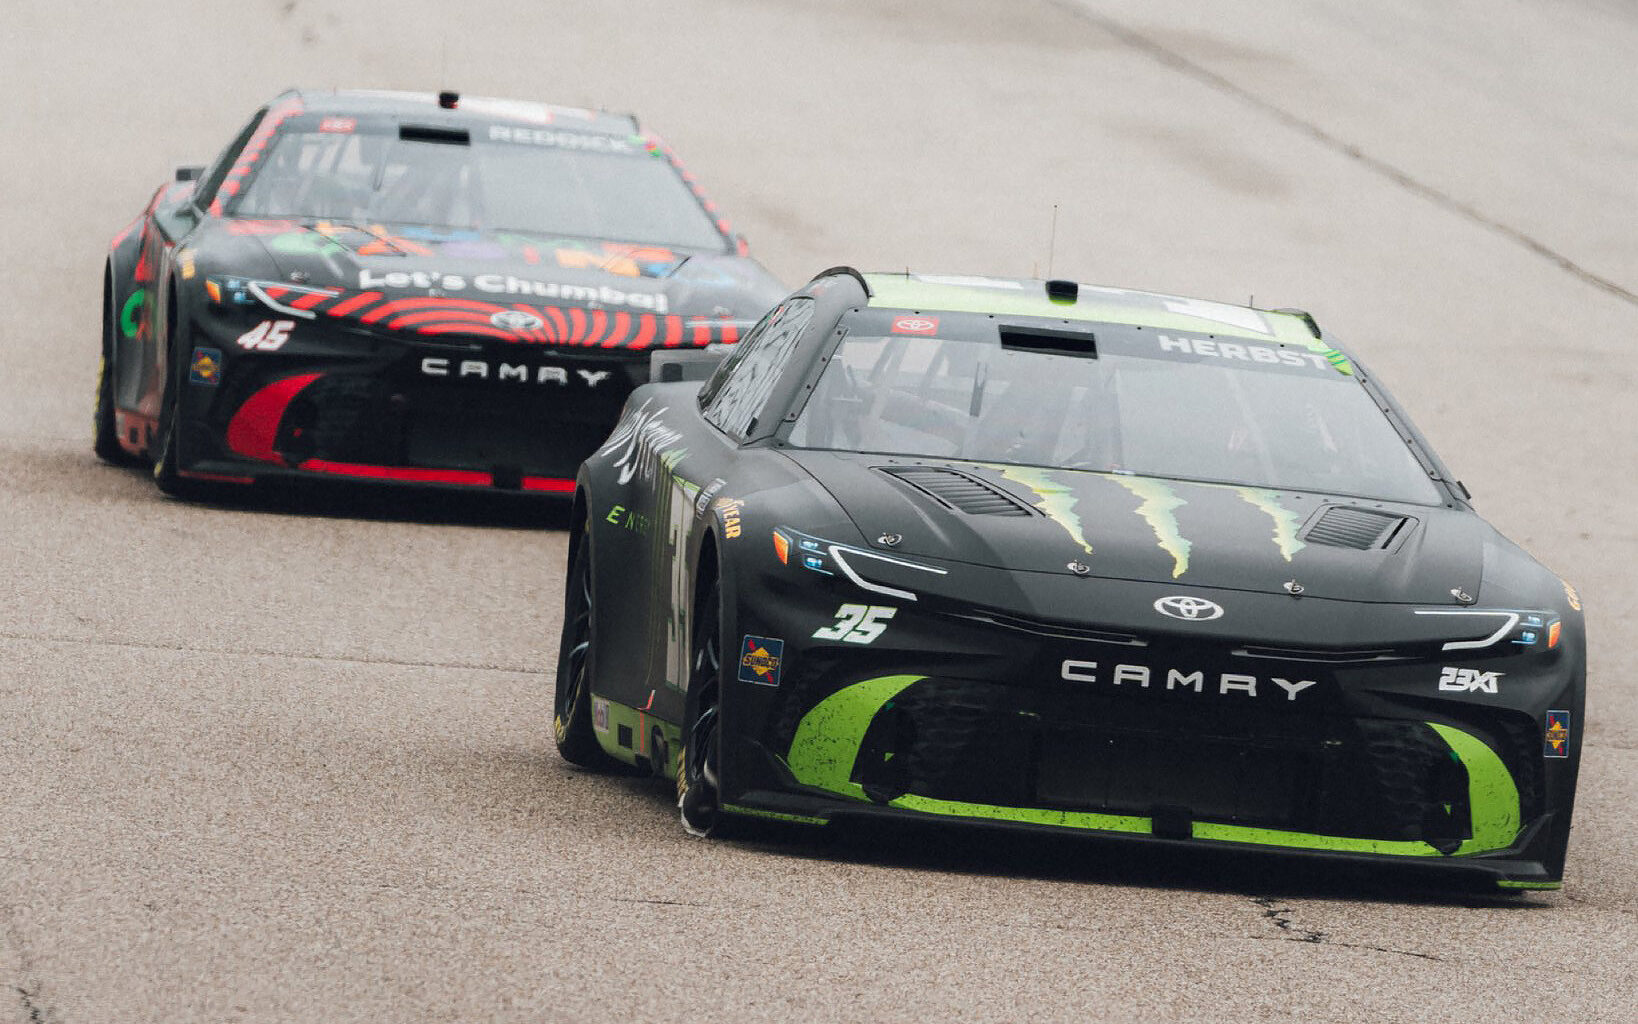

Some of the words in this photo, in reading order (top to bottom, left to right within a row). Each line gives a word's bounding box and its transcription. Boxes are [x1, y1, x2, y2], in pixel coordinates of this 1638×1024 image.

[237, 320, 296, 351] 45
[1158, 335, 1327, 370] HERBST
[421, 357, 611, 388] CAMRY
[811, 603, 898, 645] 35
[1061, 659, 1317, 701] CAMRY
